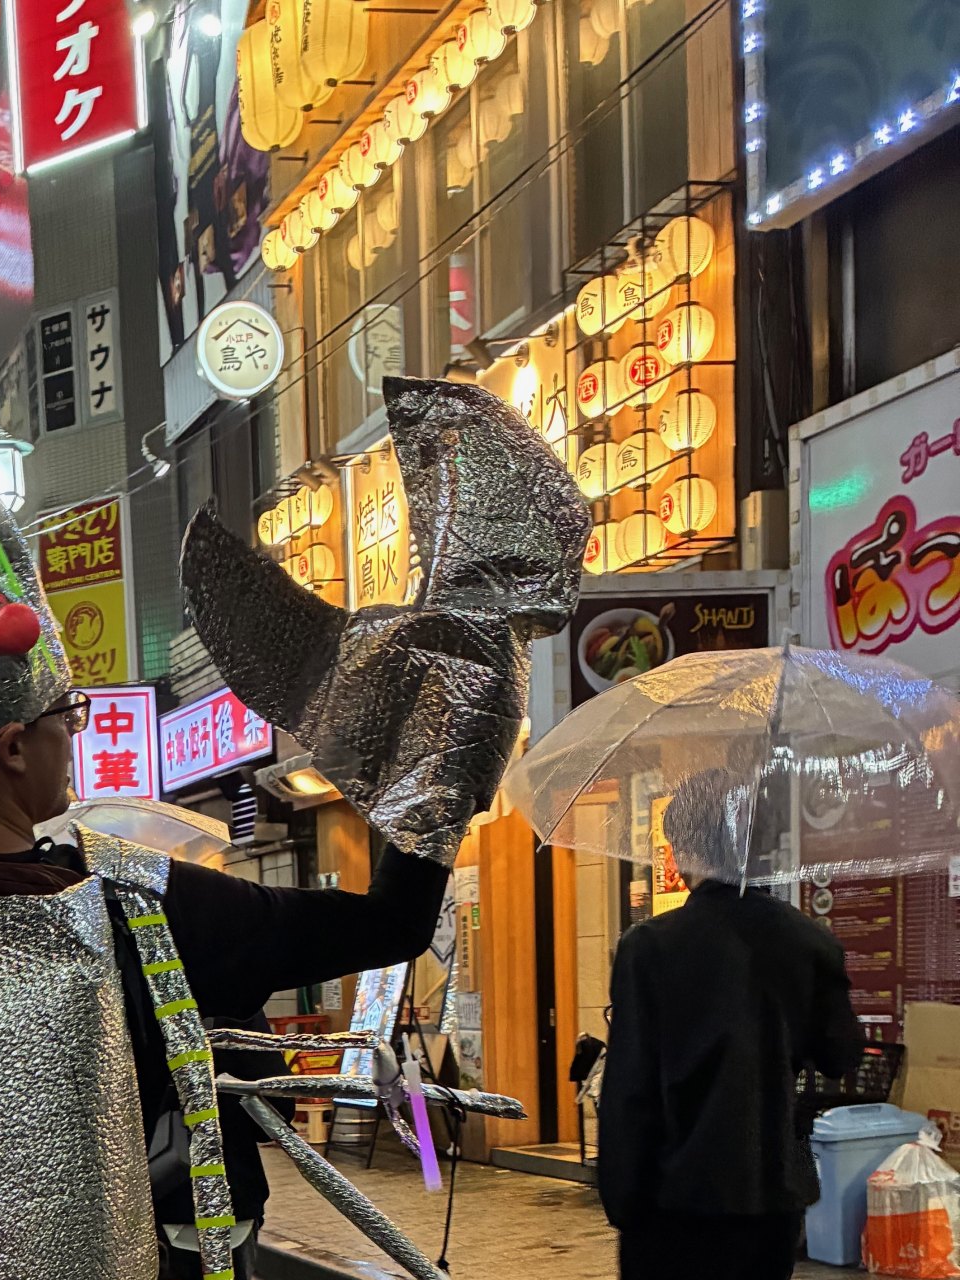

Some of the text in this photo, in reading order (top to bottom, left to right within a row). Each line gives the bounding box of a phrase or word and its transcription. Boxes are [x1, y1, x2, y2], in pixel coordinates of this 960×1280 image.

[87, 304, 113, 409] サウナ
[218, 344, 267, 372] 鳥や
[226, 332, 254, 344] 小江戸
[899, 418, 960, 484] ガー
[45, 536, 116, 575] 専門店
[356, 495, 376, 600] 焼鳥
[381, 481, 399, 592] 炭火
[91, 701, 140, 793] 中華
